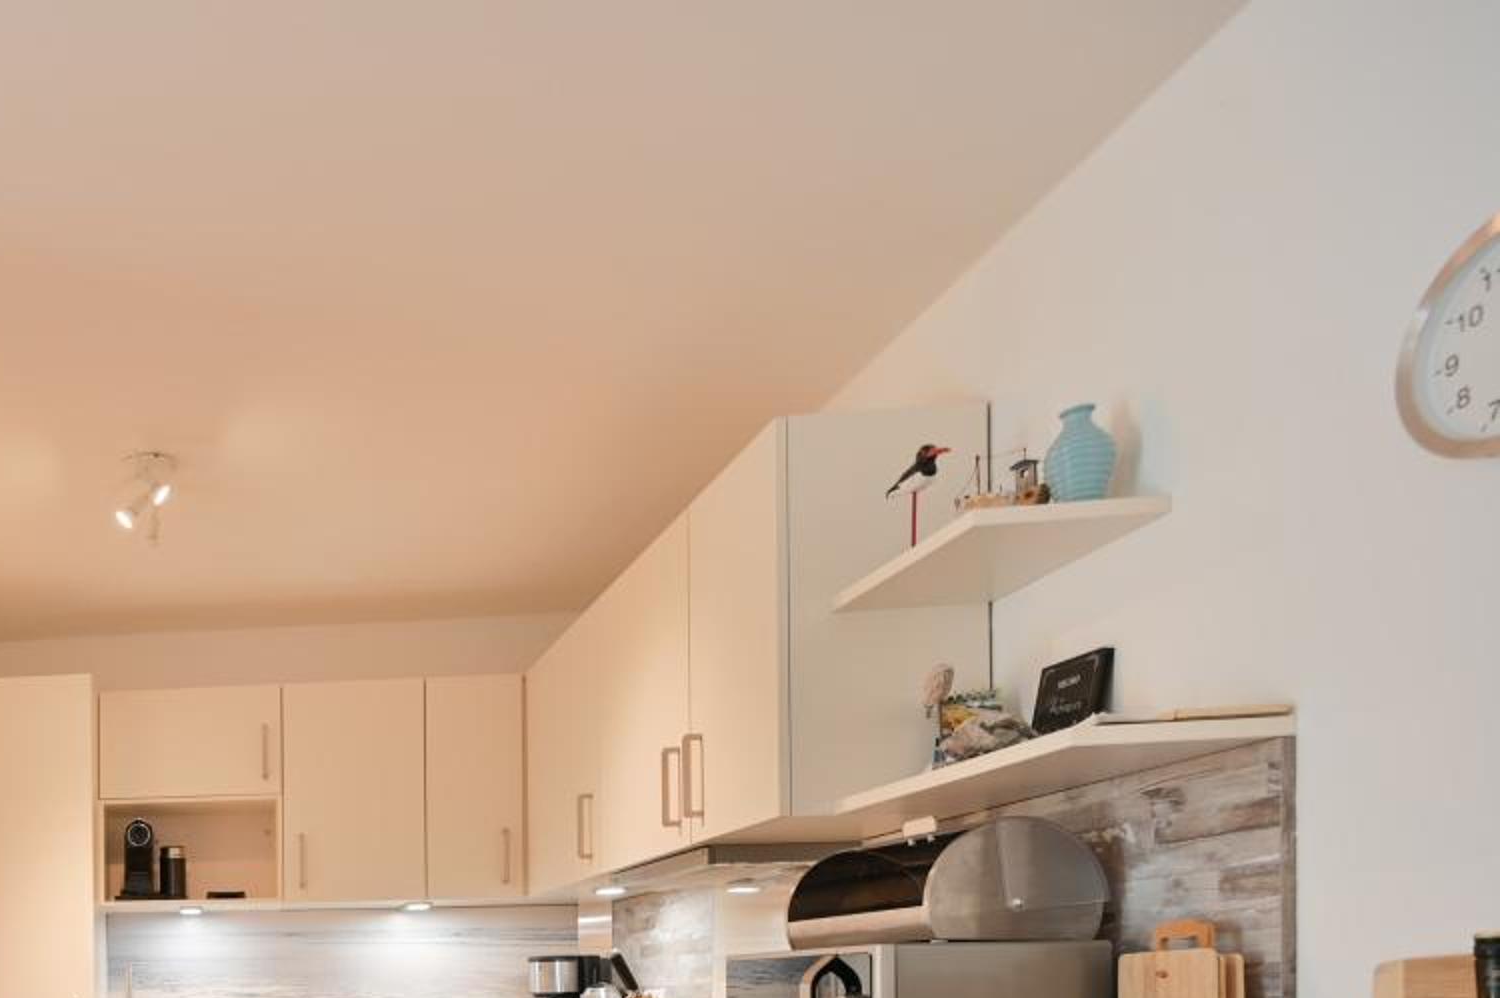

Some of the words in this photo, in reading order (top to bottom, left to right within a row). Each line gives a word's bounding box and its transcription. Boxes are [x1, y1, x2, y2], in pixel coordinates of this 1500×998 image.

[1458, 304, 1484, 332] 10
[1445, 354, 1460, 377] 9
[1456, 386, 1471, 409] 8
